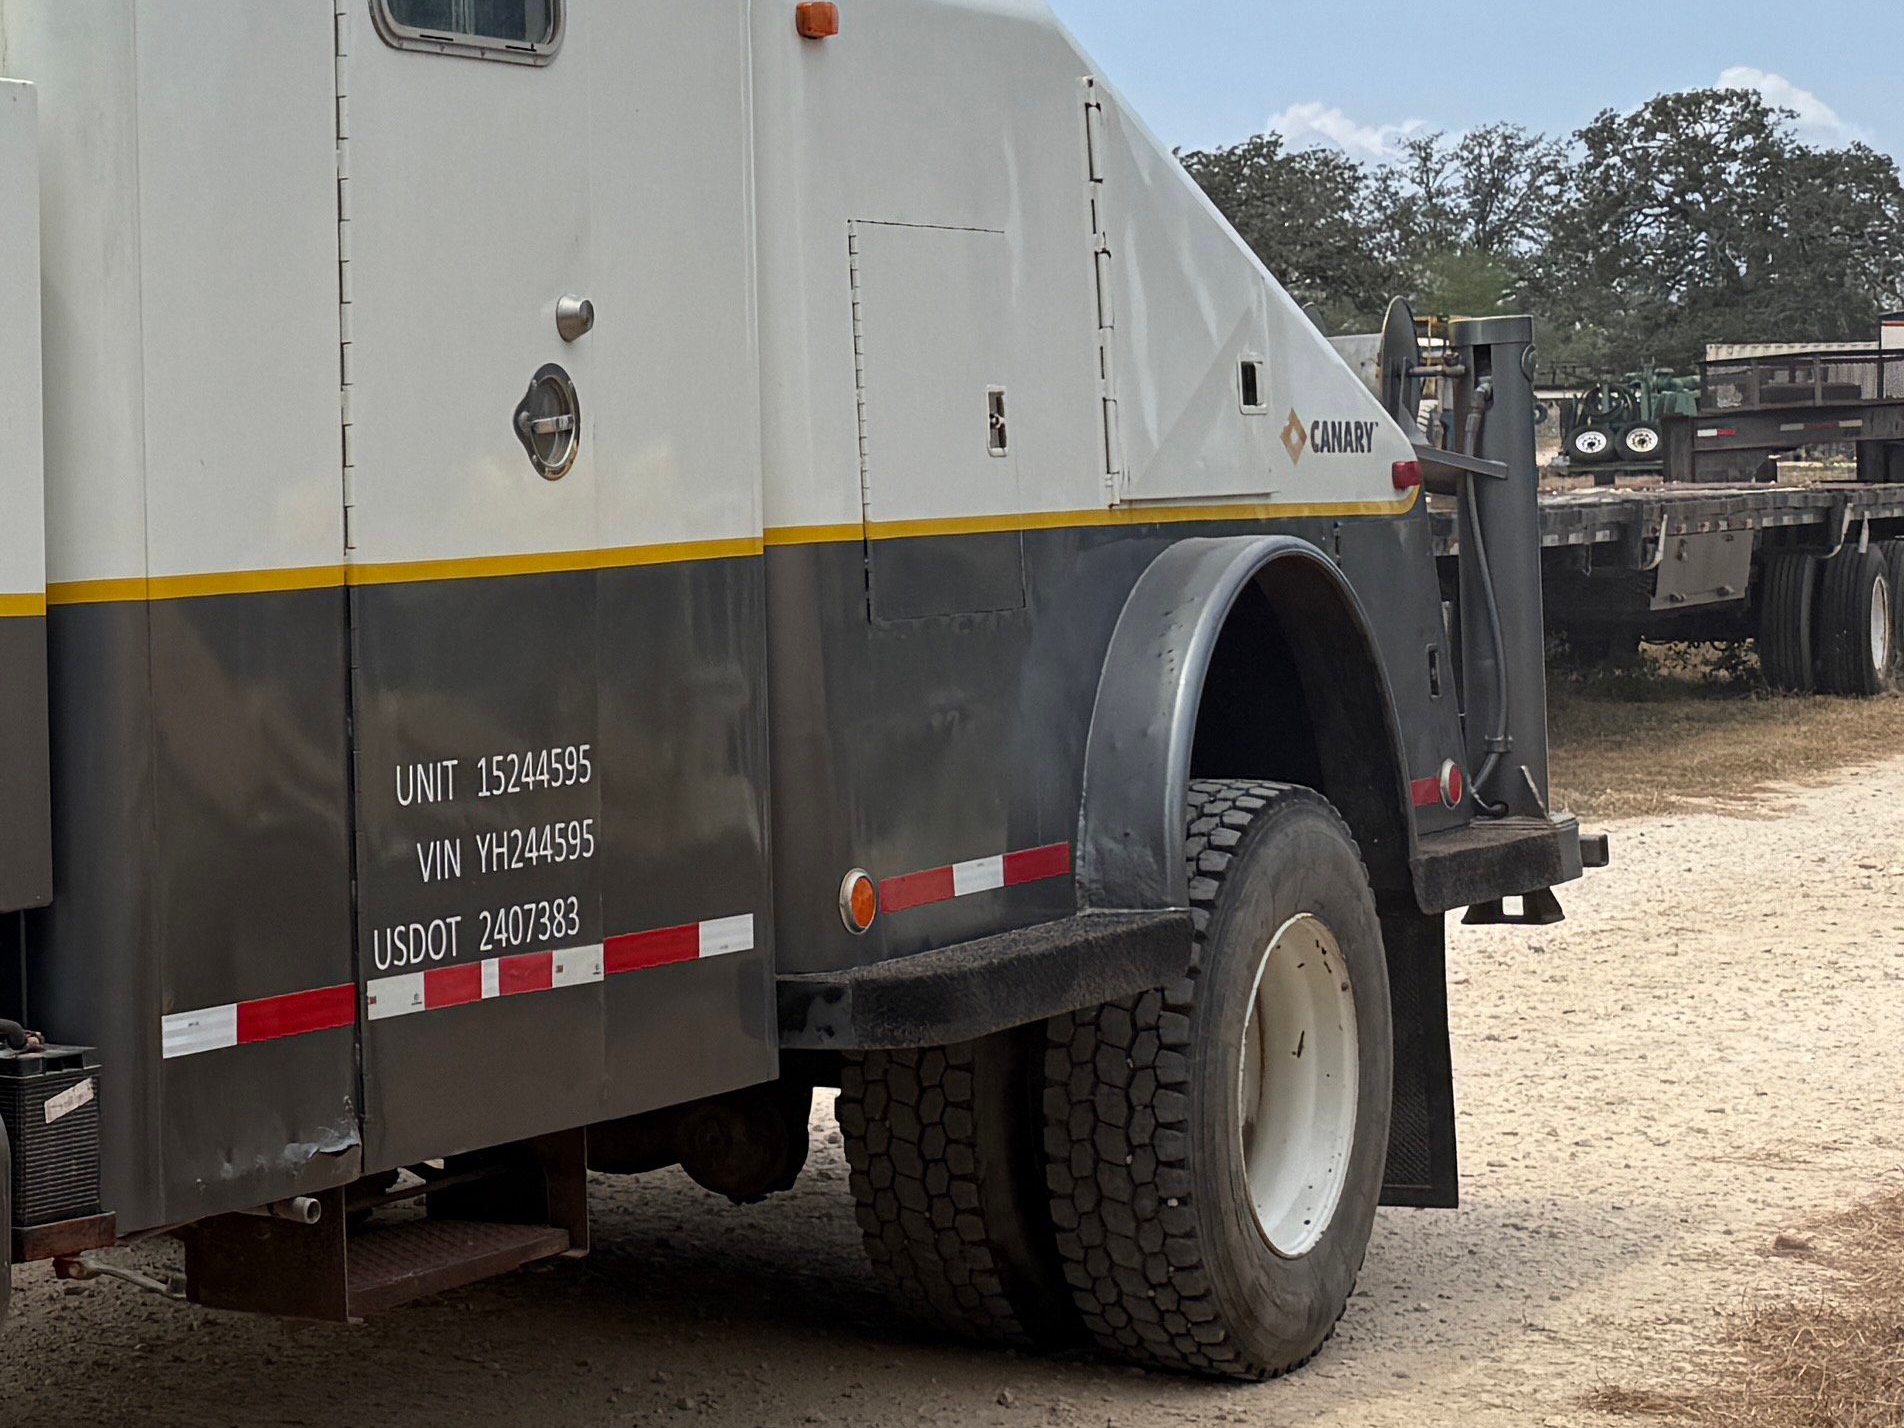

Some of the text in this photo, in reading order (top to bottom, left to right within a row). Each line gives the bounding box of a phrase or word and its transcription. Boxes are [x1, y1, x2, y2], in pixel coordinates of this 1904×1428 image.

[395, 743, 592, 807] UNIT 15244595
[416, 818, 595, 883] VIN YH244595
[372, 895, 581, 971] USDOT 2407383
